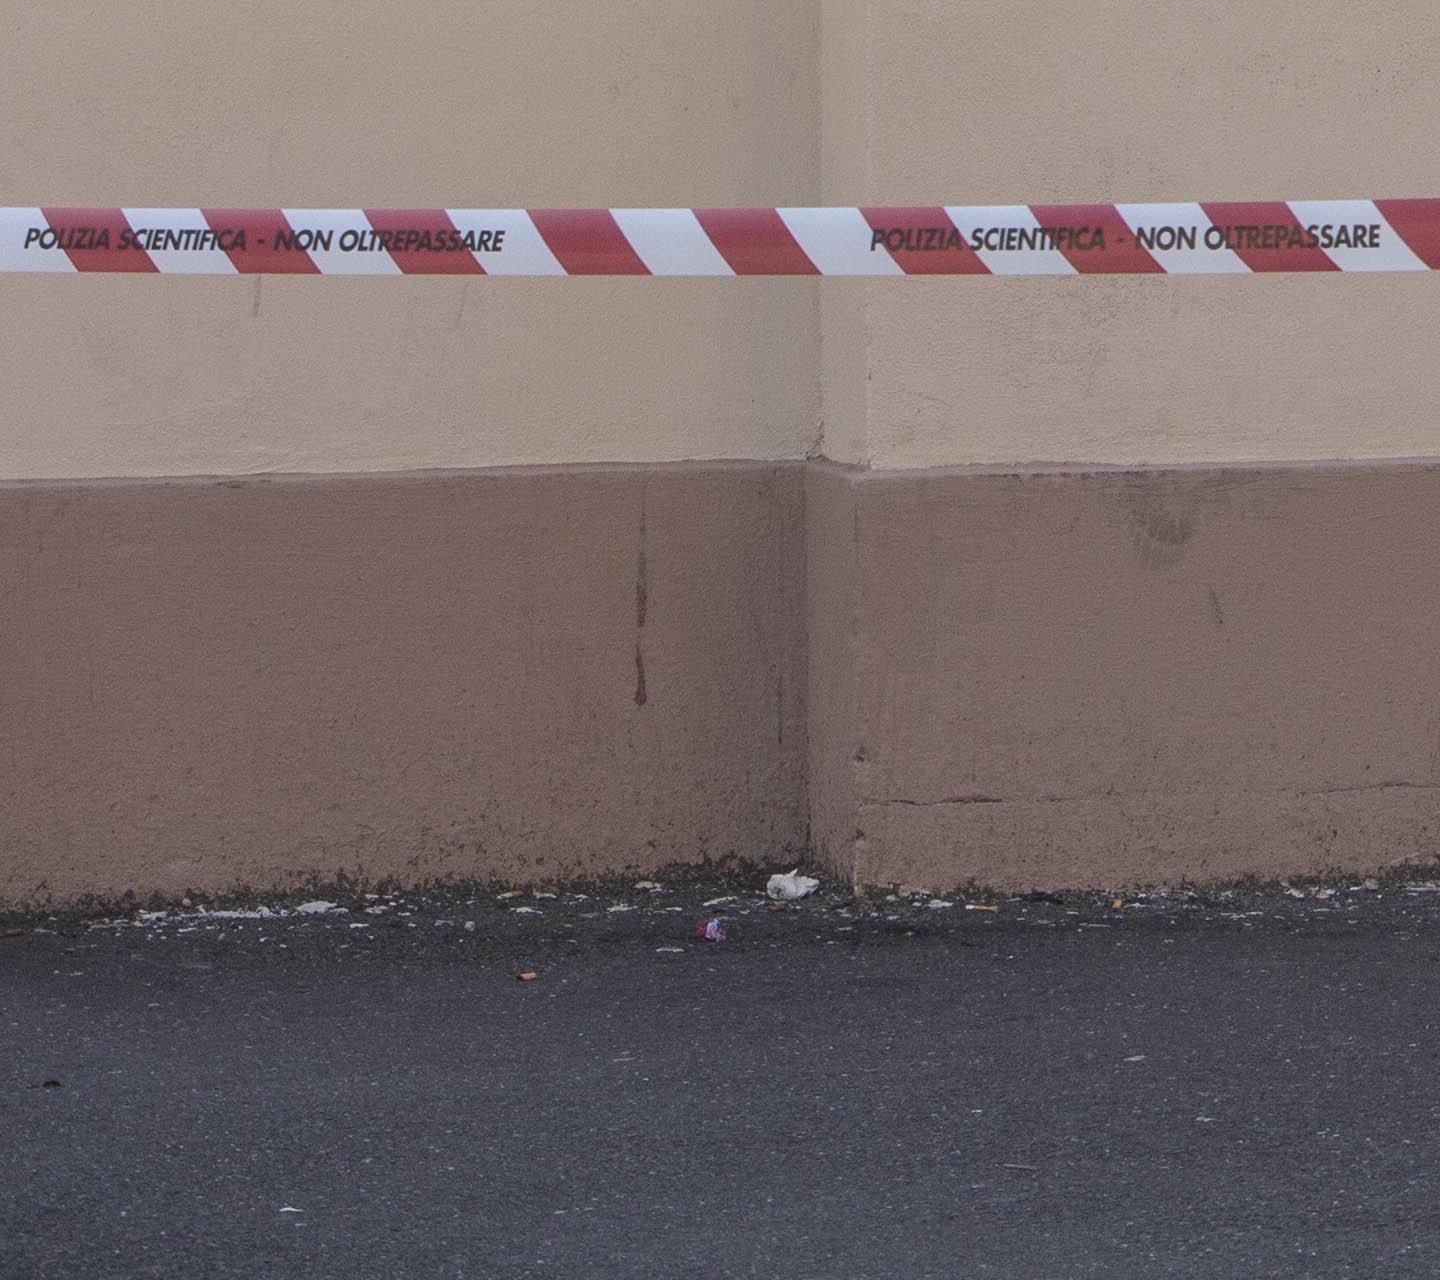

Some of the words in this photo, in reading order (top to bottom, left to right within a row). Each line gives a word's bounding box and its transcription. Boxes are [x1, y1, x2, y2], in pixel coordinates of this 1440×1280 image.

[23, 226, 111, 252] POLIZIA
[116, 227, 247, 252] SCIENTIFICA
[272, 228, 334, 252] NON
[338, 228, 506, 254] OLTREPASSARE
[869, 226, 963, 253] POLIZIA
[969, 225, 1107, 252] SCIENTIFICA
[1134, 225, 1198, 252] NON
[1202, 223, 1382, 250] OLTREPASSARE
